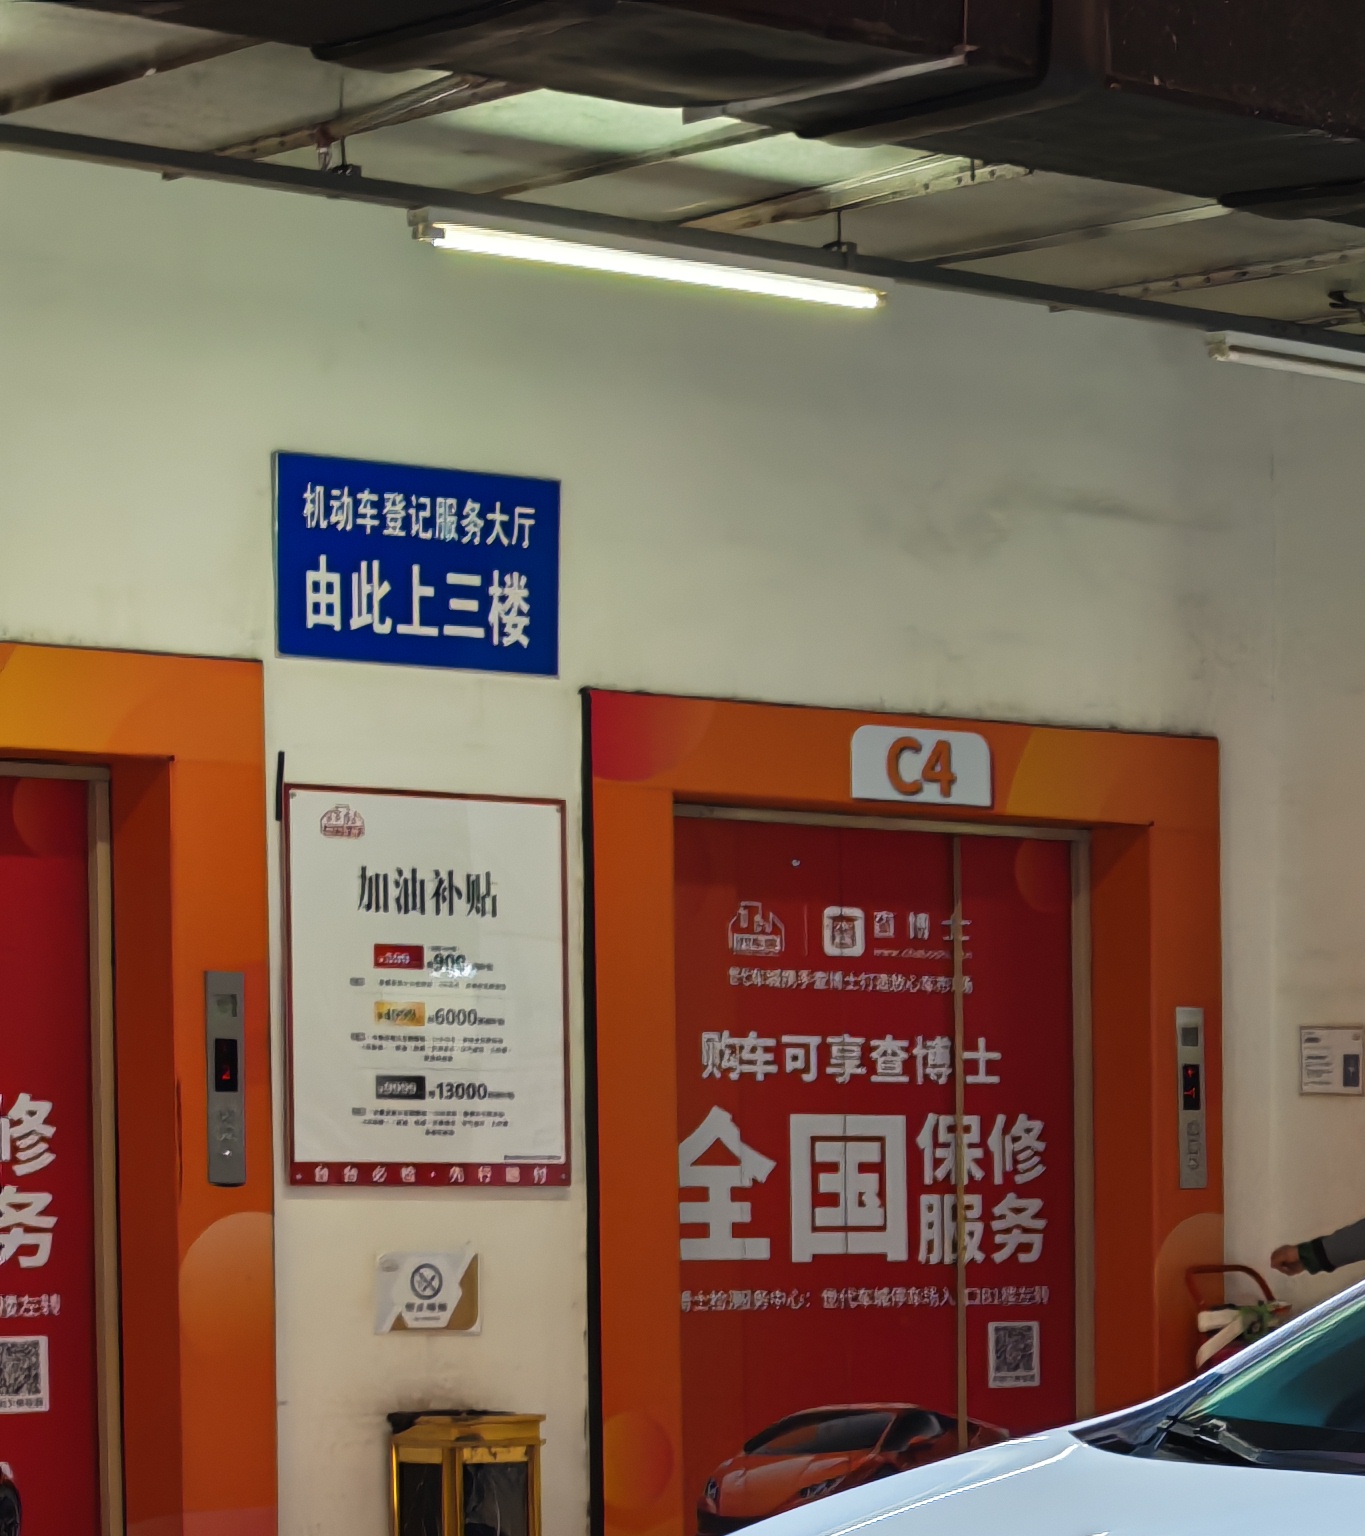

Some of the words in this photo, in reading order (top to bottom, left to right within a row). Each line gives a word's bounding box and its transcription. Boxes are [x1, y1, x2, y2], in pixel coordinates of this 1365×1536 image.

[303, 482, 535, 549] 机动车登记服务大厅
[305, 554, 531, 649] 由此上三楼
[886, 736, 957, 799] C4
[357, 865, 498, 918] 加油补贴
[702, 1030, 1002, 1085] 购车可享查博士
[0, 1093, 56, 1176] 修
[916, 1112, 1048, 1186] 保修
[678, 1105, 909, 1263] 全国
[917, 1192, 1048, 1265] 服务
